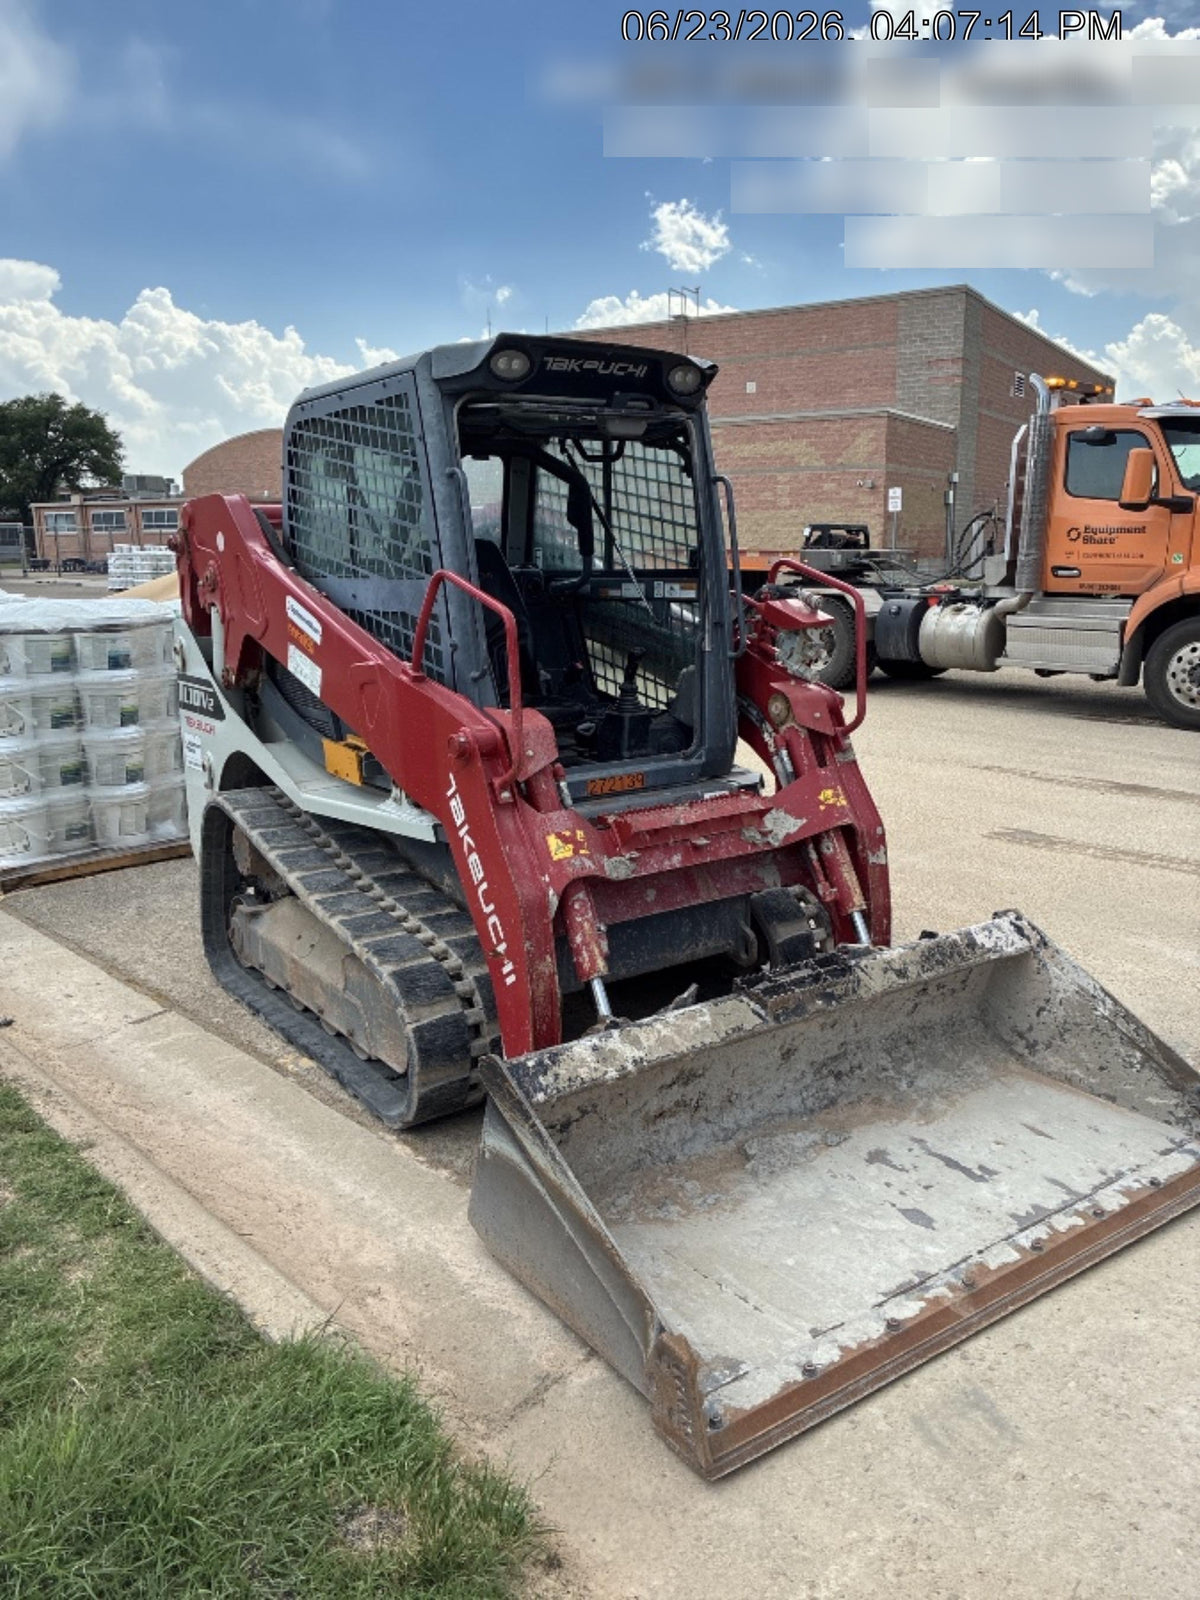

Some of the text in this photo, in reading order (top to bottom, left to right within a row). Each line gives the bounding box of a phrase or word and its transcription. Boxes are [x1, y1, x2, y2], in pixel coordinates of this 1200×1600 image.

[543, 357, 647, 377] TAKEUCHI
[1083, 525, 1146, 535] Equipment
[1082, 535, 1116, 545] Share
[446, 772, 516, 986] TAKEUCHI
